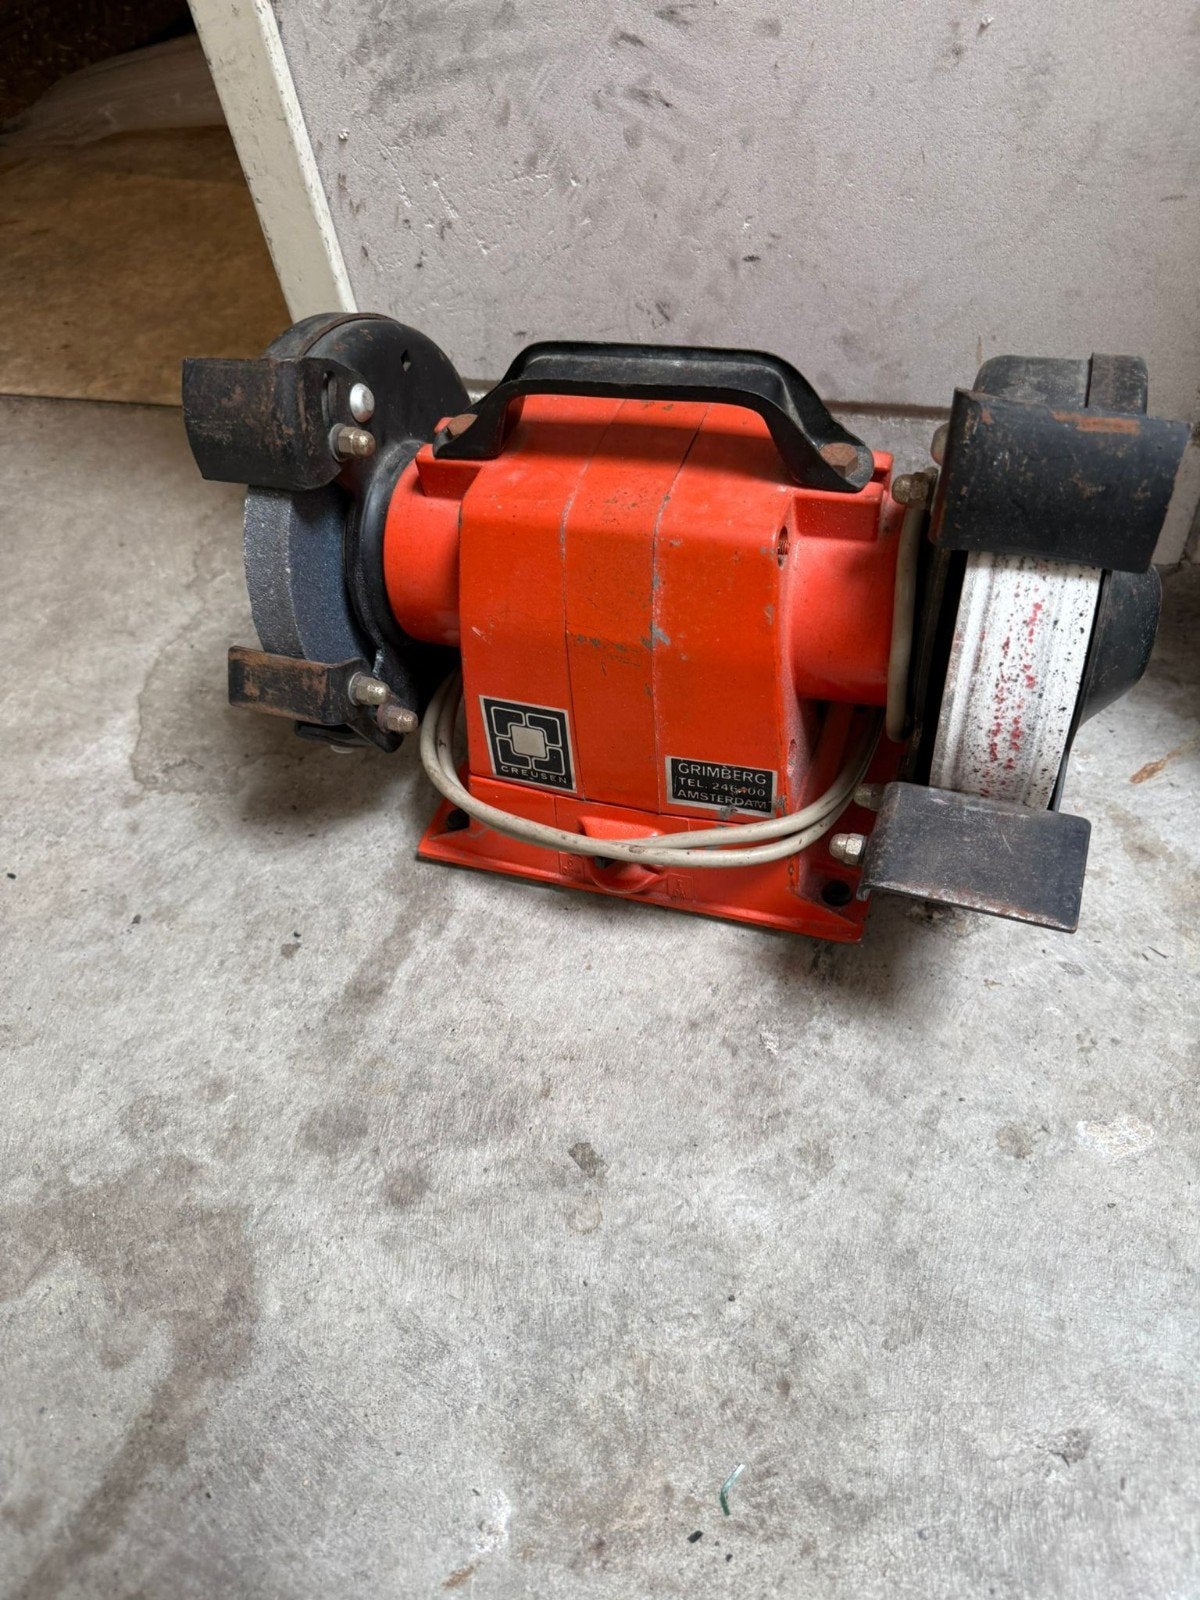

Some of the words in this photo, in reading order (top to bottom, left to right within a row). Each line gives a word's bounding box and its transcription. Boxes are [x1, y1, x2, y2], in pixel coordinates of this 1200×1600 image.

[501, 765, 567, 784] CREUSEN
[678, 763, 767, 785] GRIMBERG
[678, 777, 708, 789] TEL.
[712, 782, 766, 797] 24600
[677, 789, 767, 808] AMSTERDAM
